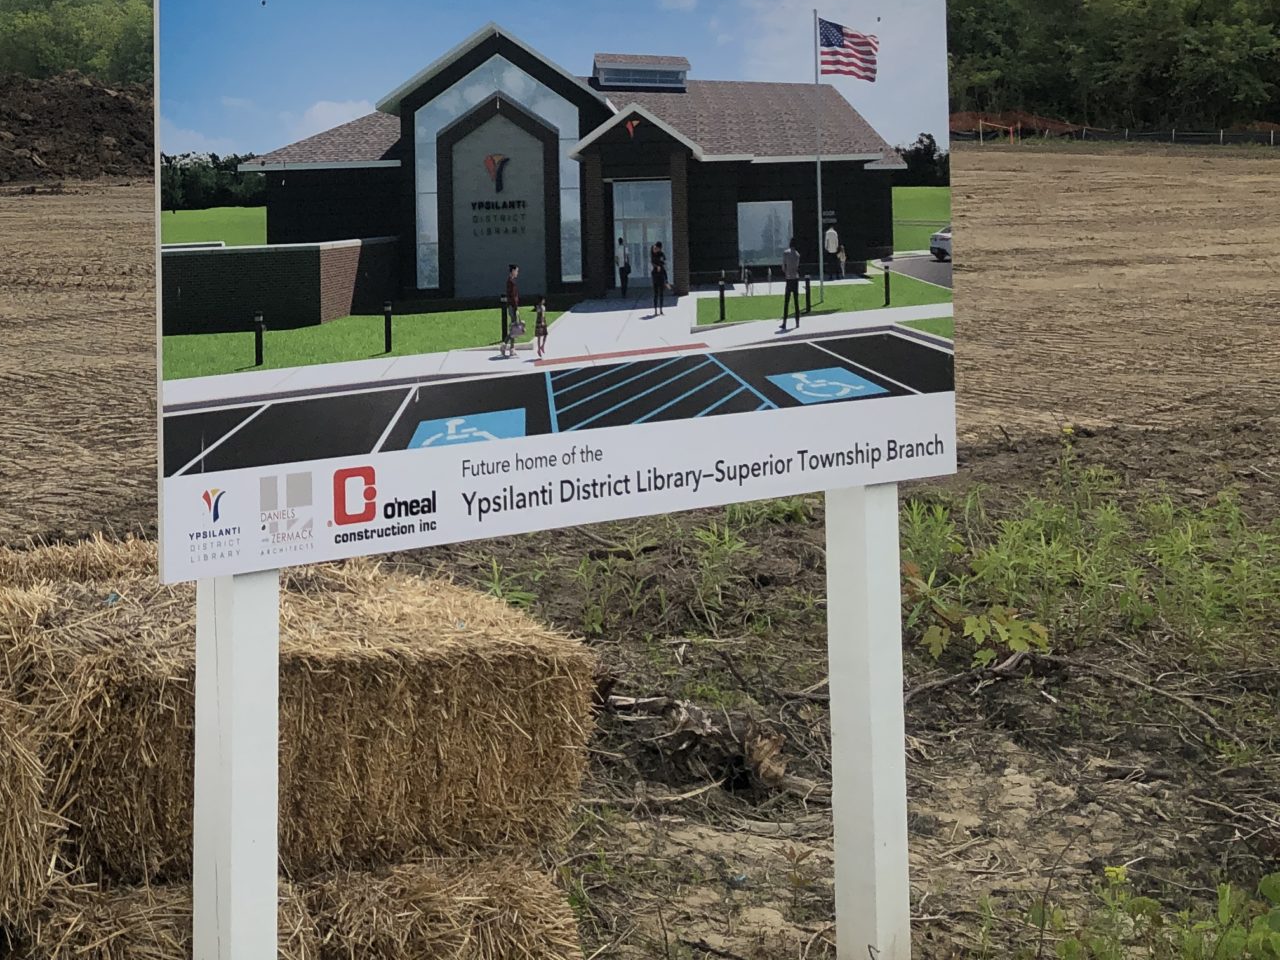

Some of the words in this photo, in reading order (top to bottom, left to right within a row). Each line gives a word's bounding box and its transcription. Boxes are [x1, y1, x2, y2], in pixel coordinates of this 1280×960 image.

[471, 200, 526, 210] YPSILANTI
[472, 214, 526, 224] DISTRICT
[472, 226, 526, 236] LIBRARY
[461, 458, 511, 478] Future
[515, 452, 558, 471] home
[561, 445, 577, 465] of
[580, 444, 604, 463] the
[461, 481, 553, 522] Ypsilanti
[559, 473, 631, 503] District
[797, 442, 882, 469] Township
[886, 433, 945, 462] Branch
[383, 490, 437, 520] o'neal
[260, 508, 296, 522] DANIELS
[188, 526, 241, 541] YPSILANTI
[271, 528, 314, 544] ZERMACK
[334, 522, 416, 544] construction
[418, 519, 438, 533] inc
[189, 538, 241, 552] DISTRICT
[260, 542, 315, 556] ARCHITECTS
[190, 549, 241, 563] LIBRARY
